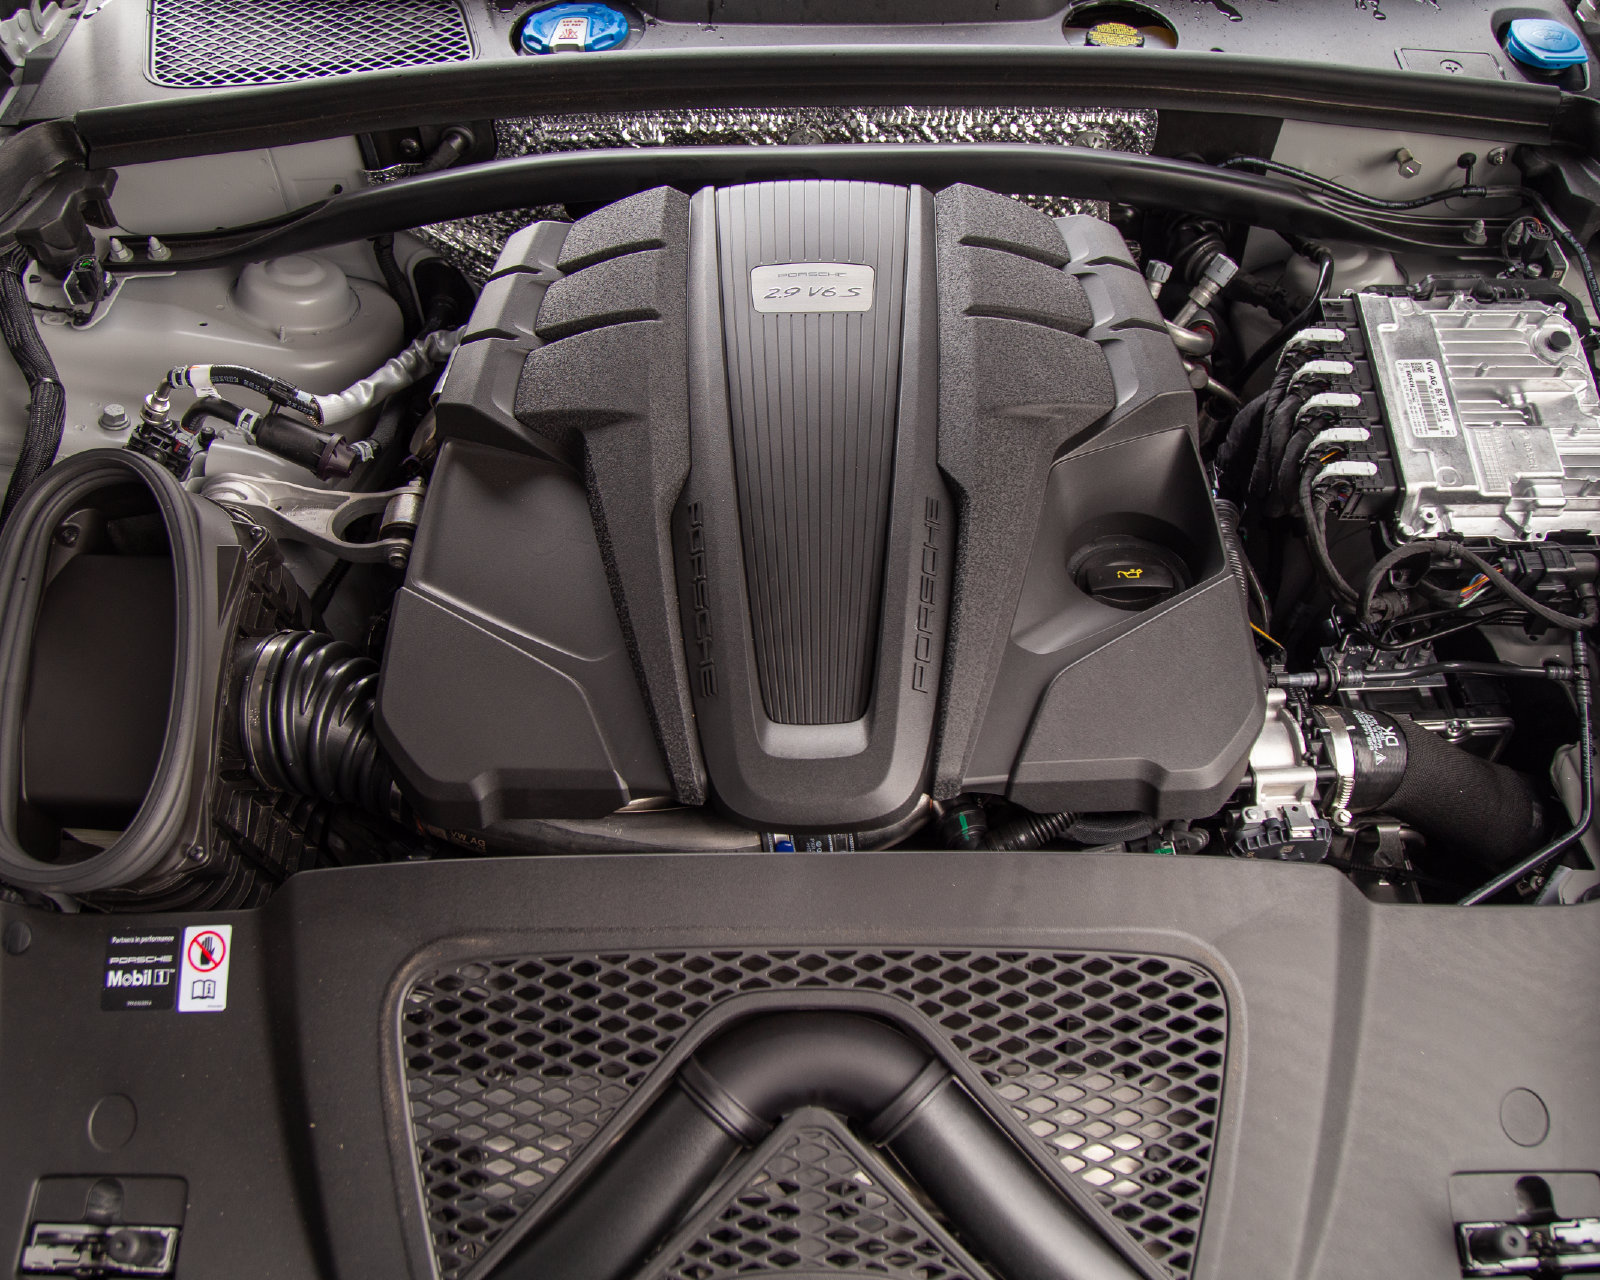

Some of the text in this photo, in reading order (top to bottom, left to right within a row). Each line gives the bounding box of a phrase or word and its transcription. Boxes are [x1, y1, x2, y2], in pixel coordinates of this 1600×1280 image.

[763, 286, 862, 299] 2.9 V6 S
[1425, 361, 1435, 374] VW
[1429, 375, 1438, 386] AG
[912, 496, 941, 694] PORSCHE
[1381, 726, 1400, 746] DK
[109, 955, 173, 964] PORSCHE
[107, 969, 152, 987] Mobil
